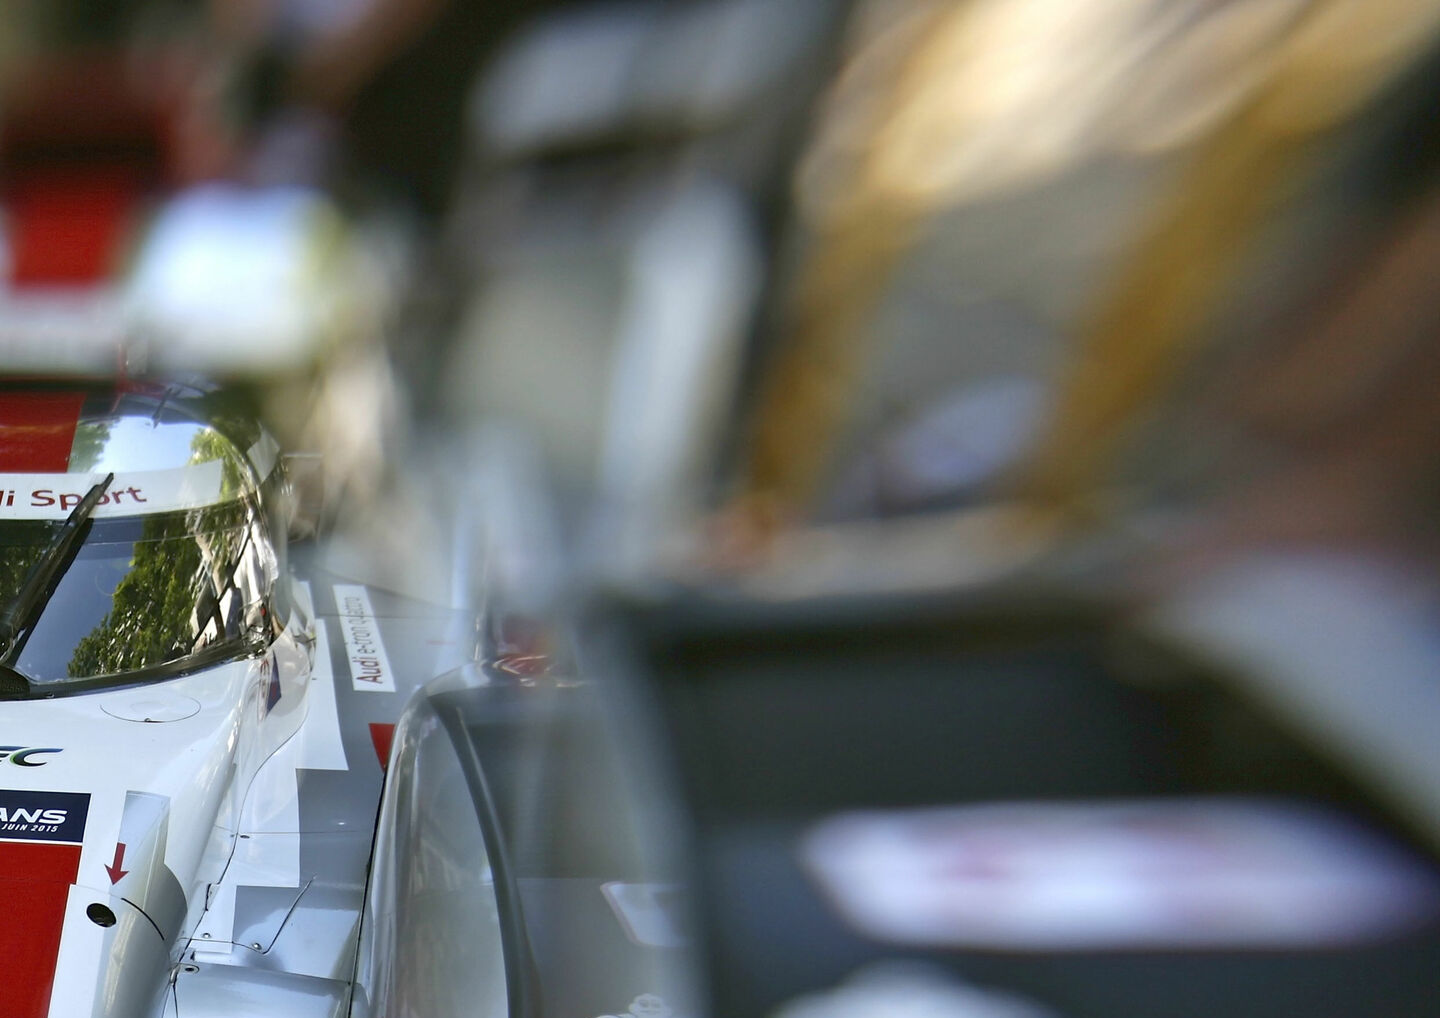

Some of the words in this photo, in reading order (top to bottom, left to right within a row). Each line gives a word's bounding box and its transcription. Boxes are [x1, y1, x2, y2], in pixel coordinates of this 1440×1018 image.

[349, 625, 376, 655] e-tron
[351, 656, 384, 685] Audi
[1, 823, 28, 831] JUIN
[30, 824, 59, 833] 2015
